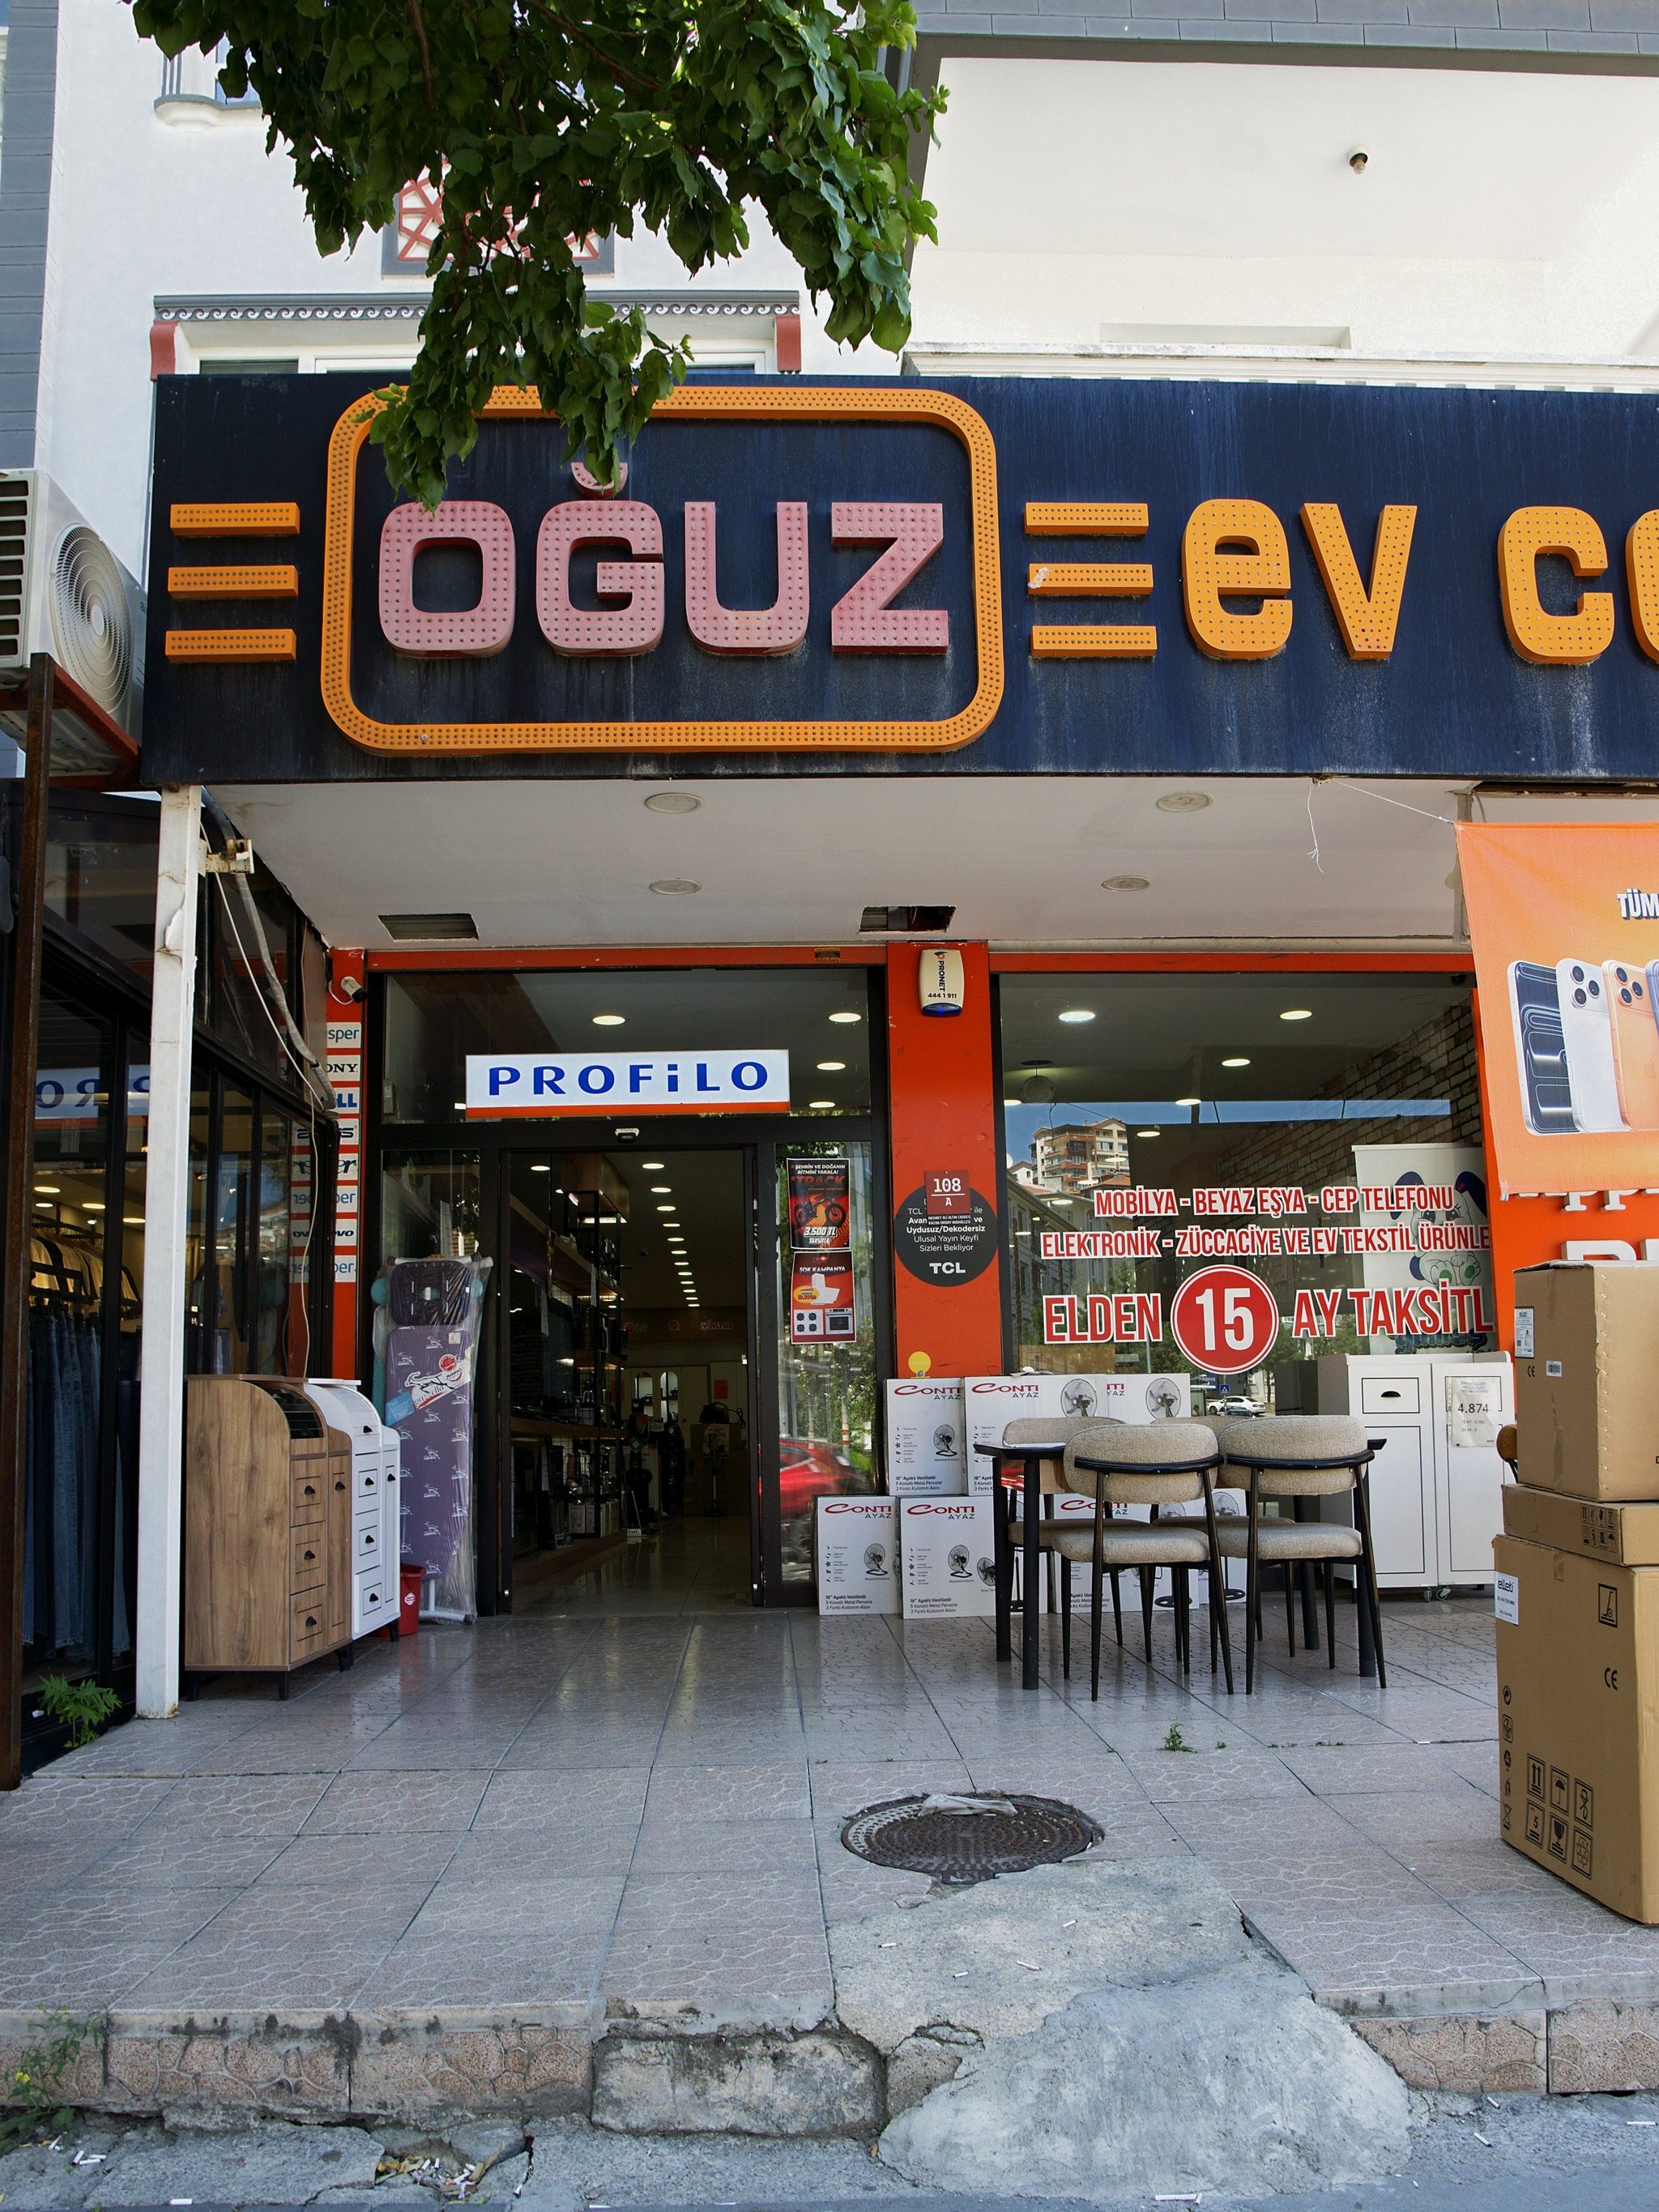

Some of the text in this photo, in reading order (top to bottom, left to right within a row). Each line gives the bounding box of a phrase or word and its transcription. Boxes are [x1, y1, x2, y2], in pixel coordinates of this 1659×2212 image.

[378, 462, 949, 658] OĞUZ
[933, 1178, 962, 1193] 108
[945, 1197, 952, 1206] A
[1094, 1186, 1178, 1217] MOBİLYA
[1193, 1188, 1255, 1215] BEYAZ
[1257, 1187, 1307, 1217] EŞYA
[1321, 1187, 1358, 1213] CEP
[1361, 1185, 1454, 1213] TELEFONU
[906, 1225, 986, 1234] Uydusuz/Dekodersiz
[938, 1235, 958, 1243] Yayın
[960, 1234, 979, 1243] Keyfi
[1040, 1226, 1162, 1259] ELEKTRONİK
[1175, 1224, 1282, 1256] ZÜCCACİYE
[1282, 1228, 1310, 1255] VE
[1311, 1227, 1339, 1255] EV
[1340, 1221, 1417, 1253] TEKSTİL
[919, 1244, 974, 1252] Sizleri Bekliyor
[929, 1262, 966, 1274] TCL
[1043, 1278, 1494, 1351] ELDEN 15 AY TAKSİTL
[1457, 1403, 1489, 1413] 4.874
